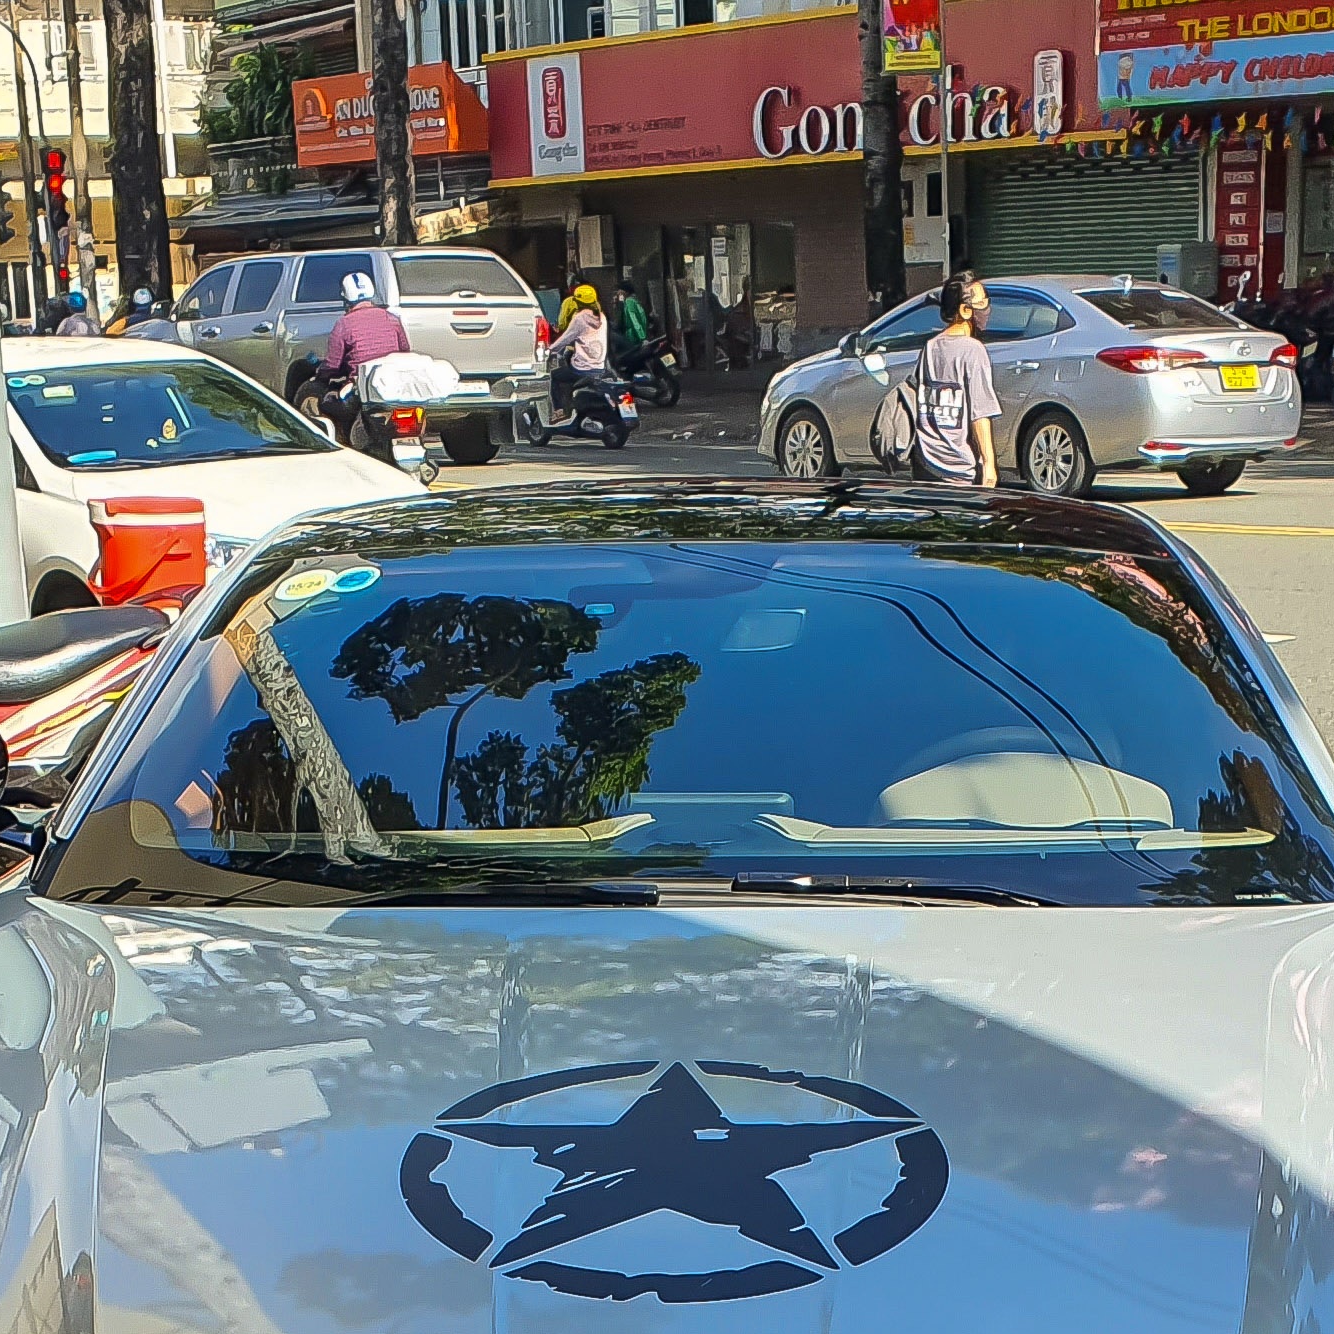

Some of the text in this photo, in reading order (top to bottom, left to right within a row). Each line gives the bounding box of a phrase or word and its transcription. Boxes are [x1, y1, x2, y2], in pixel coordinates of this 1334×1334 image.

[1176, 16, 1231, 42] THE
[1149, 59, 1238, 90] HAPPY
[753, 64, 1012, 158] Gon cha
